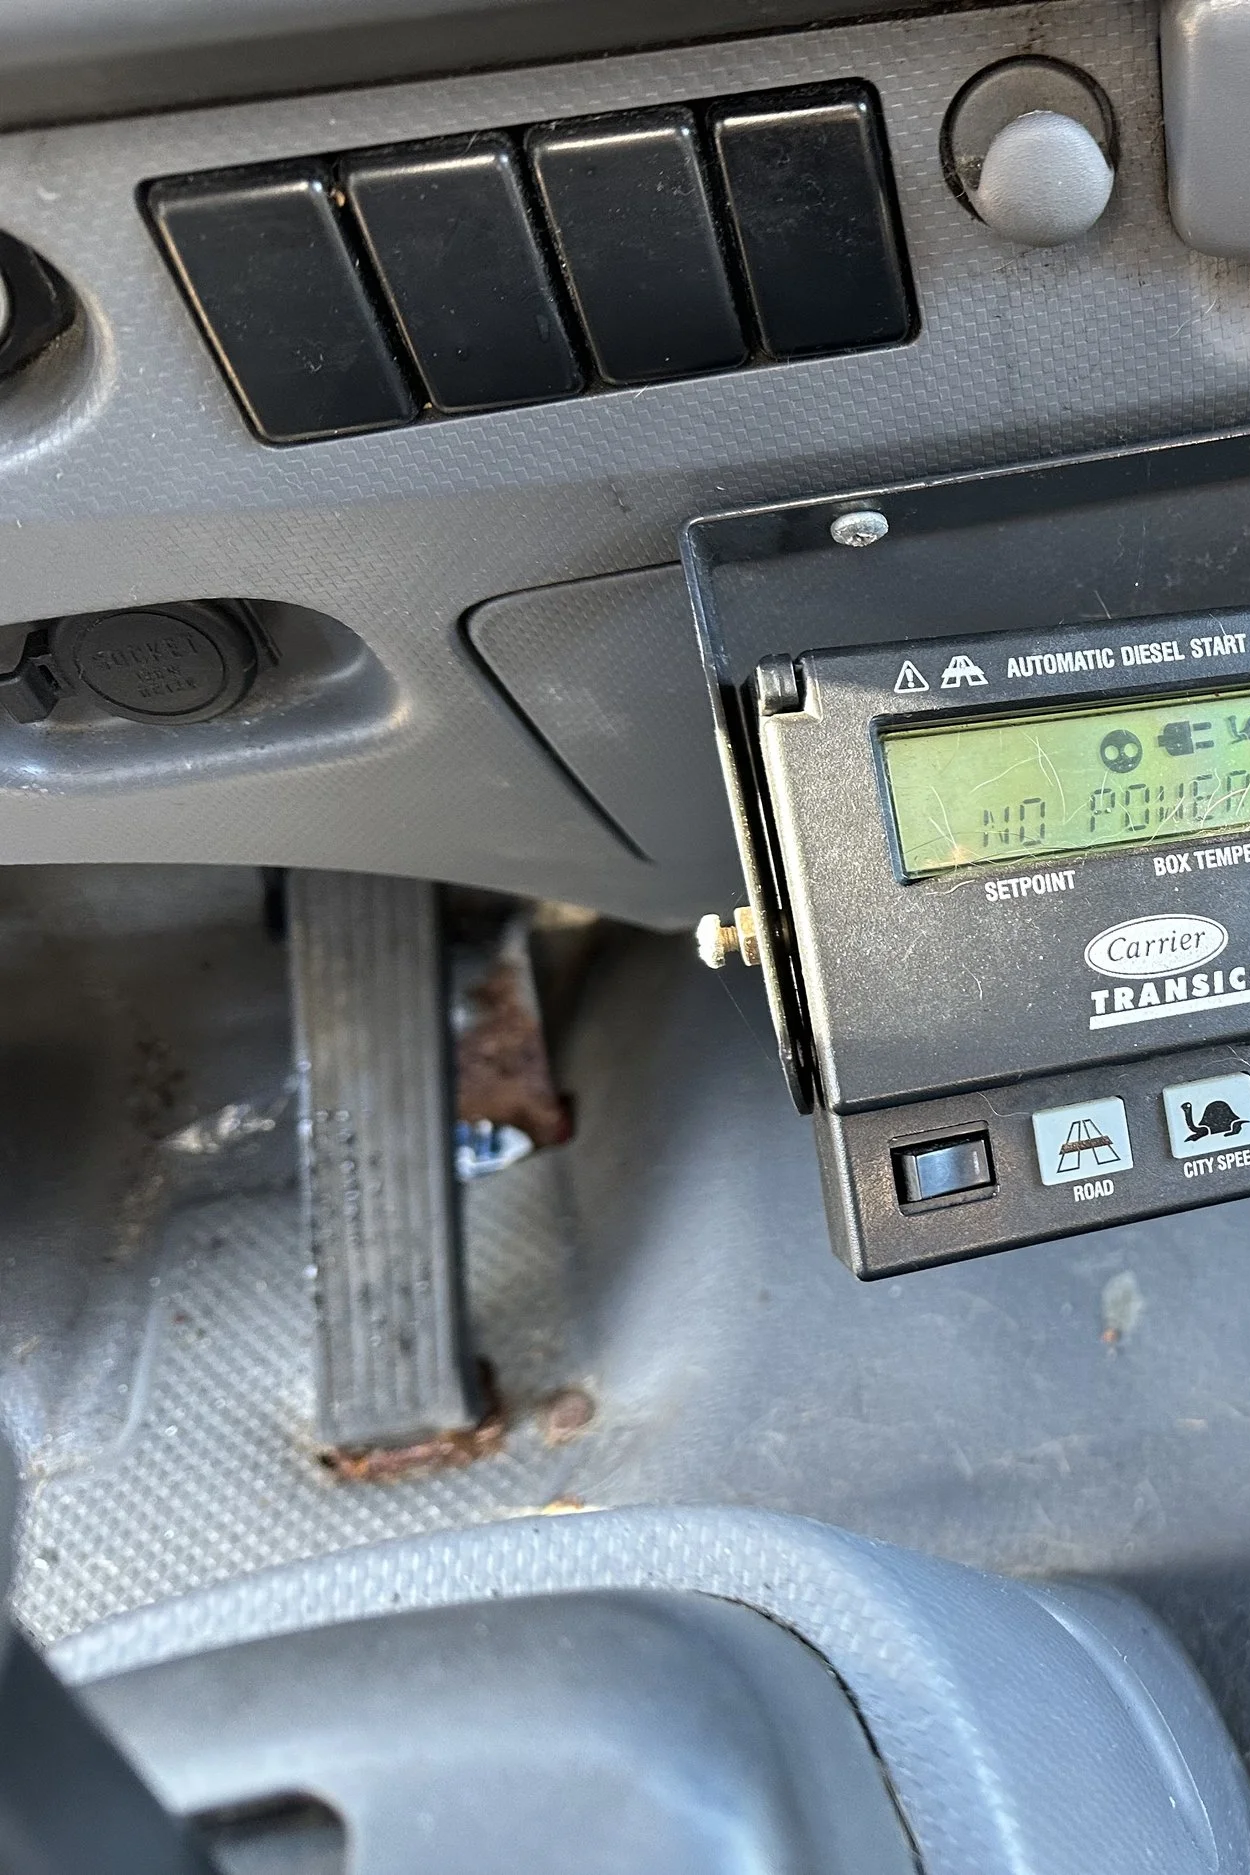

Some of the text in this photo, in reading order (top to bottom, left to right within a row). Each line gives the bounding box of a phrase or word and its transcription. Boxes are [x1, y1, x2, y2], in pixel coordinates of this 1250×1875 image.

[1007, 633, 1246, 679] AUTOMATIC DIESEL START
[983, 797, 1046, 848] NO
[1153, 854, 1192, 877] BOX
[984, 870, 1076, 902] SETPOINT
[1106, 929, 1206, 963] Carrier
[1183, 1158, 1214, 1179] CITY
[1073, 1179, 1114, 1202] ROAD
